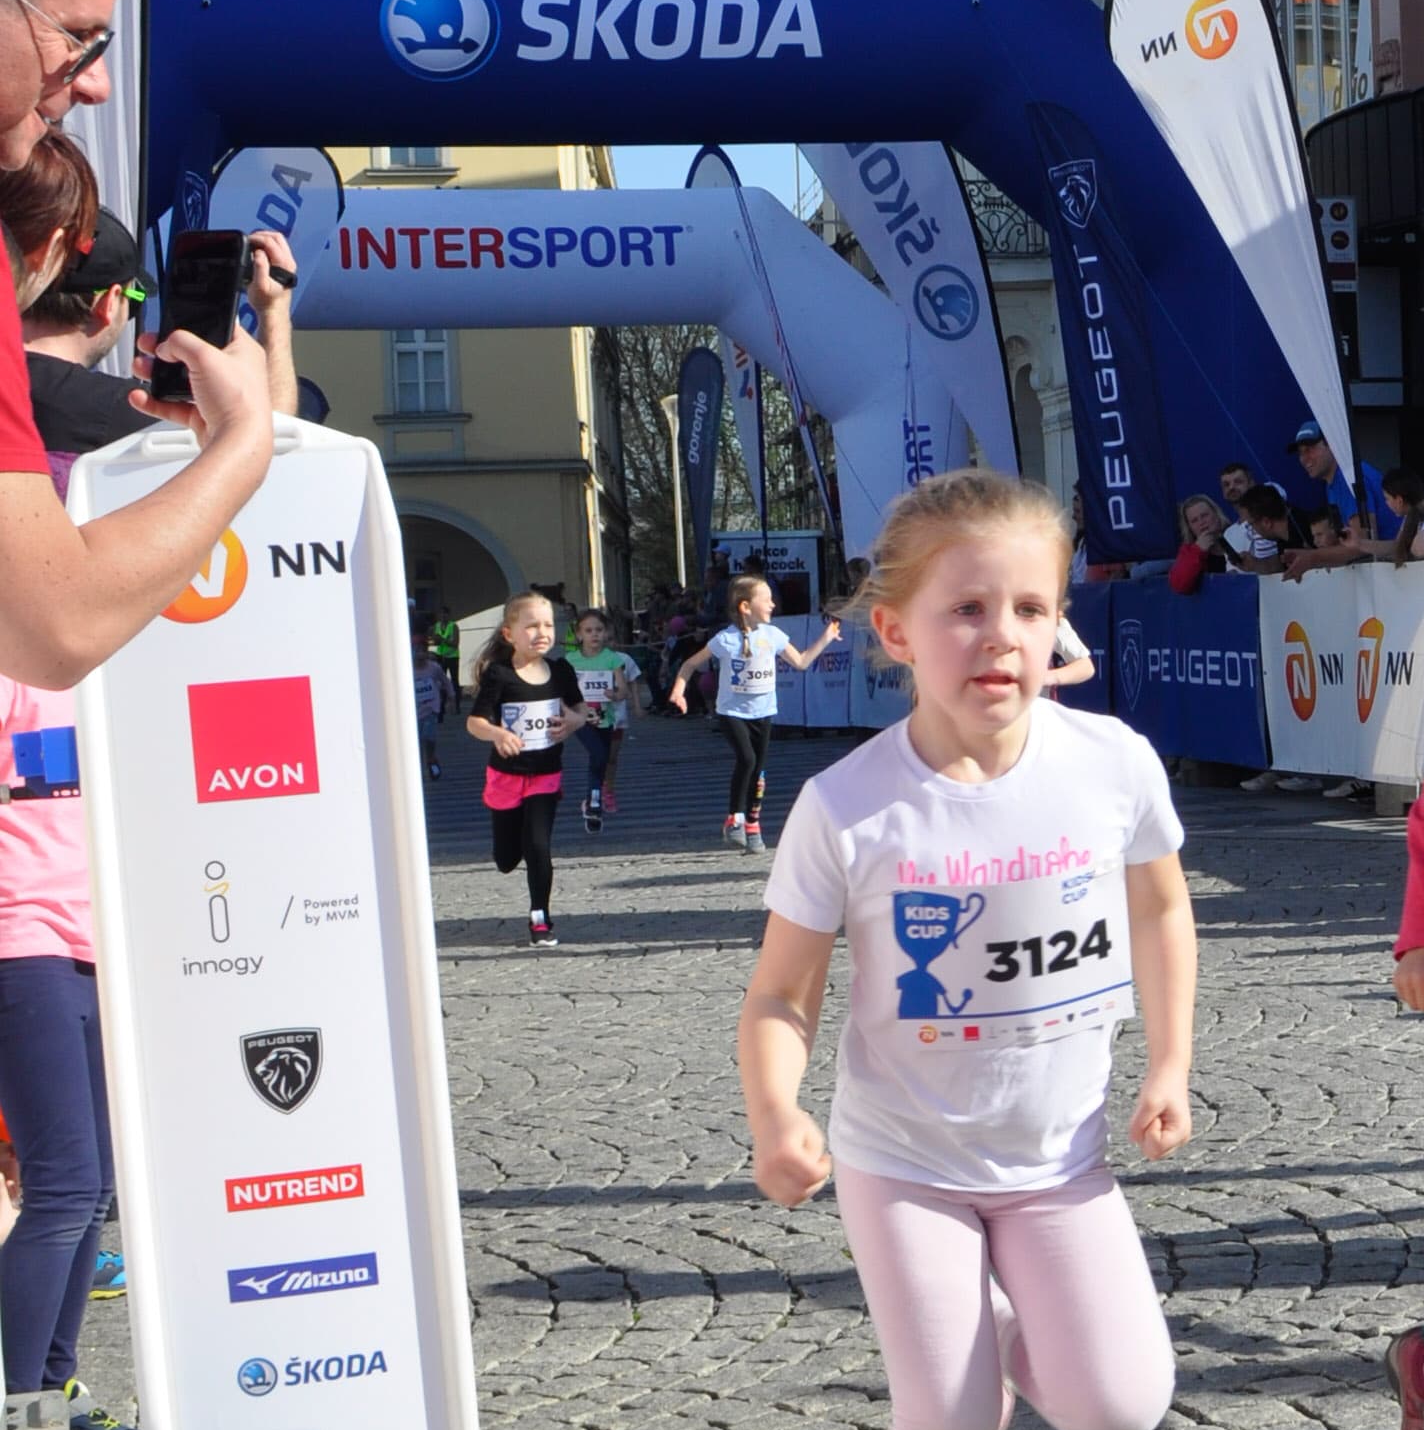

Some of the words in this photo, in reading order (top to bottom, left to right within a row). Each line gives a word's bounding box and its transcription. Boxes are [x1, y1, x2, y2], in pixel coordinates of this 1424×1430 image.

[340, 226, 684, 269] INTERSPORT
[1072, 245, 1133, 531] PEUGEOT
[688, 391, 708, 465] gorenje
[268, 539, 347, 579] NN
[1148, 649, 1258, 688] PEUGEOT
[1319, 653, 1345, 685] NN
[1384, 650, 1415, 686] NN
[207, 762, 305, 793] AVON
[303, 894, 360, 911] Powered
[1062, 888, 1088, 905] CUP
[304, 912, 321, 928] by
[325, 908, 360, 923] MVM
[904, 906, 950, 921] KIDS
[906, 925, 947, 939] CUP
[182, 954, 264, 976] innogy
[984, 918, 1112, 983] 3124
[247, 1034, 314, 1050] PEUGEOT
[234, 1172, 358, 1205] NUTREND
[284, 1350, 388, 1386] ŠKODA
